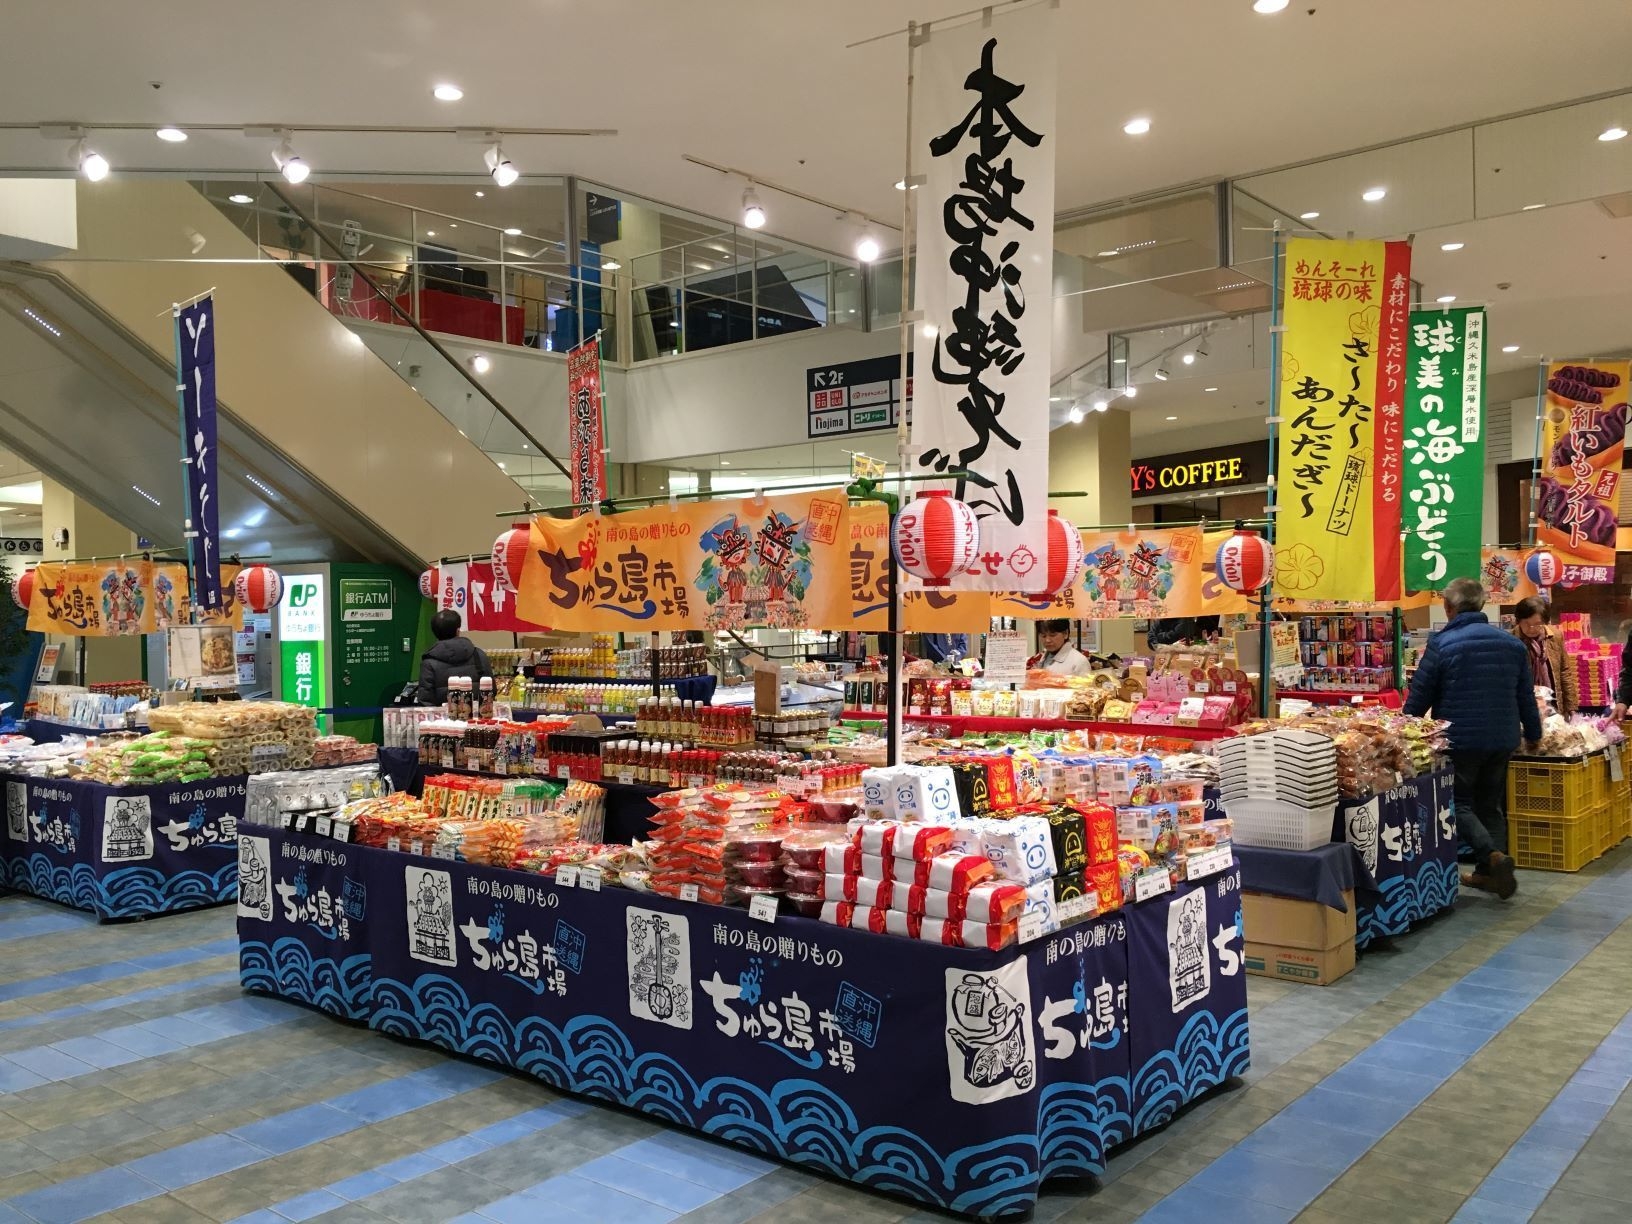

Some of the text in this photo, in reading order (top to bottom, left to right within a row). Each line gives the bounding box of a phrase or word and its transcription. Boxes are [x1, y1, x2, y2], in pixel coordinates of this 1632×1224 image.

[1295, 260, 1377, 278] めんそーれ
[1292, 280, 1373, 303] 琉球の味
[829, 370, 844, 386] 2F
[1381, 272, 1407, 502] 素材にこだわり 味にこだわる
[1403, 320, 1465, 582] 球美の海ぶどう
[1160, 457, 1243, 488] COFFEE
[1562, 404, 1602, 549] 紅いもタルト
[1595, 471, 1615, 499] 元祖
[1332, 458, 1364, 531] 琉球ドーナツ
[606, 522, 690, 543] 南の島の贈りもの
[900, 514, 921, 569] Orion
[537, 544, 690, 619] ちゅら島市場
[1225, 547, 1241, 583] Orion
[1540, 559, 1551, 581] Orion
[236, 575, 248, 606] Orion
[289, 584, 318, 607] JP
[345, 592, 388, 604] 銀行ATM
[295, 652, 313, 701] 銀行
[168, 783, 246, 805] 南の島の贈りも
[157, 812, 238, 852] ちゅら島
[281, 842, 347, 867] 南の島の贈りもの
[275, 877, 351, 942] ちゅら島市場
[467, 876, 560, 909] 南の島の贈りもの
[459, 917, 568, 997] ちゅら島市場
[712, 923, 844, 968] 南の島の贈りもの
[1045, 920, 1127, 966] 南の島の贈りも
[700, 971, 856, 1074] ちゅら島市場
